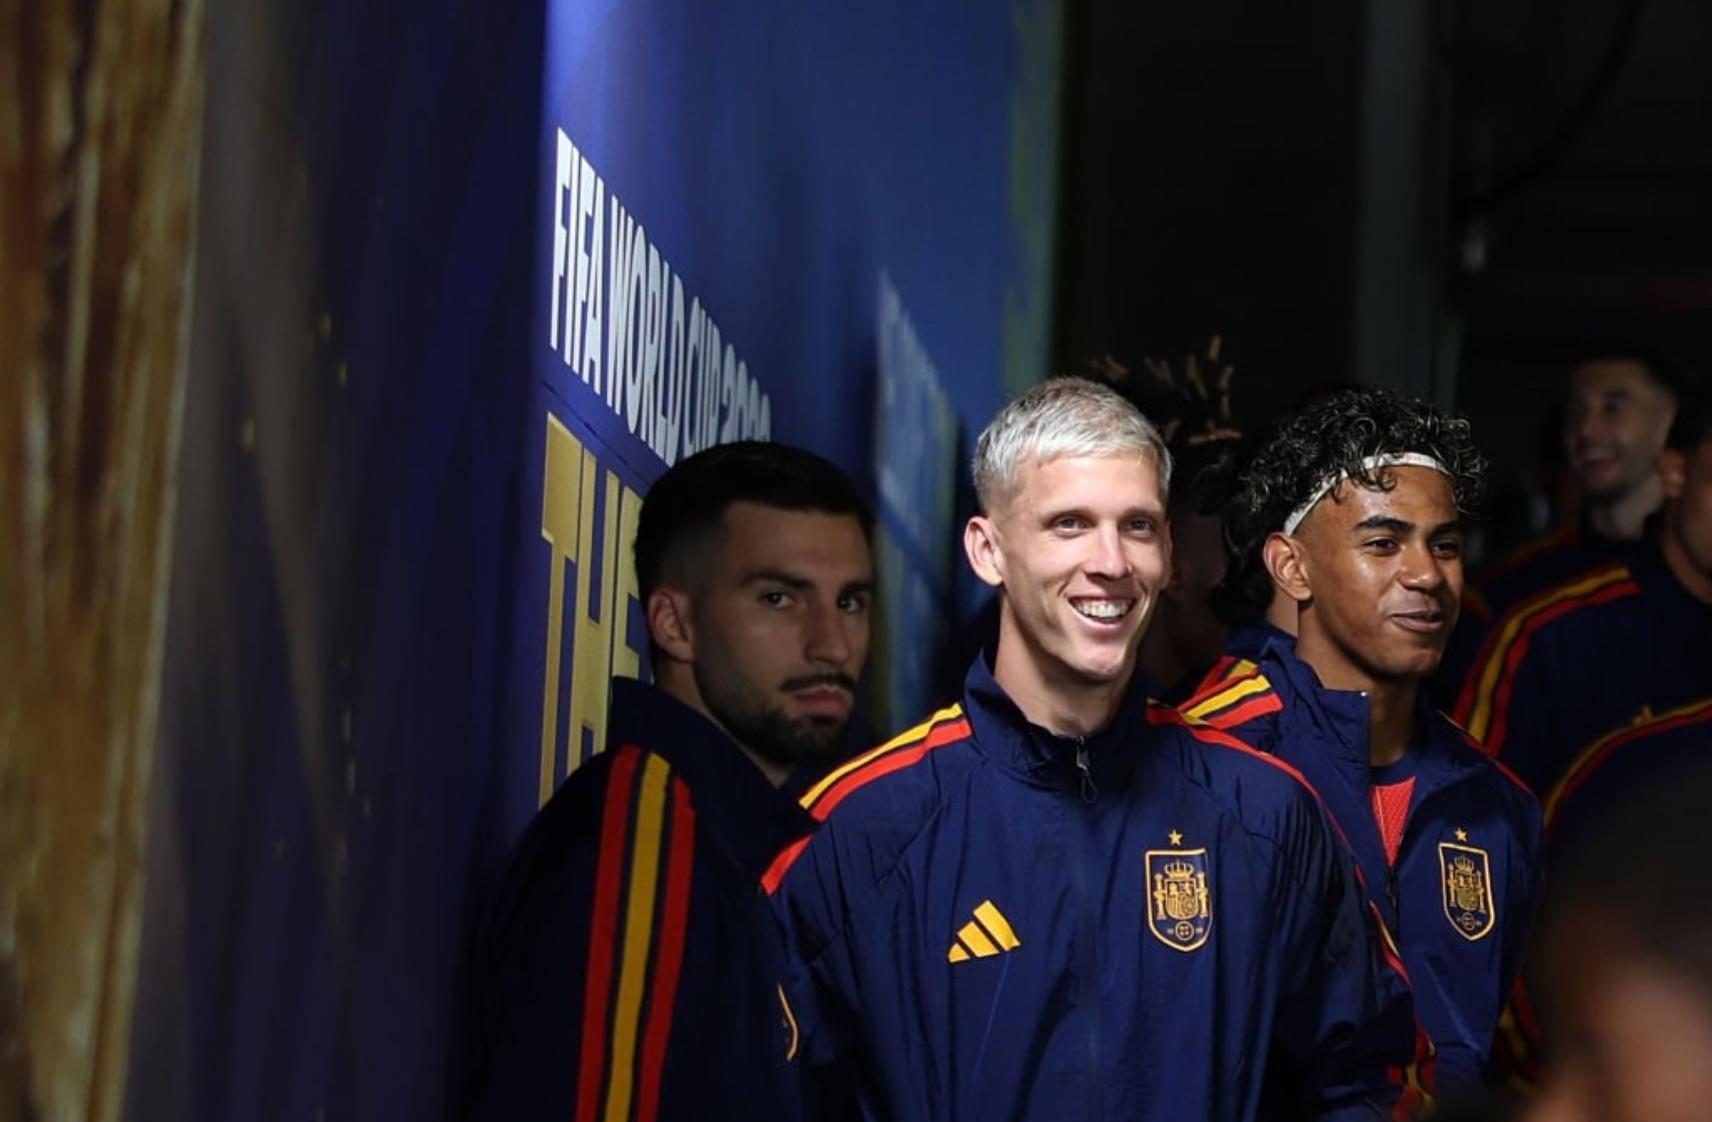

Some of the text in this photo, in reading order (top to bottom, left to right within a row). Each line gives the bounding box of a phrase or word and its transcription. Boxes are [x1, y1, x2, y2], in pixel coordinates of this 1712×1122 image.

[550, 126, 605, 396] FIFA
[606, 193, 686, 469] WORLD
[682, 296, 722, 459] CUP
